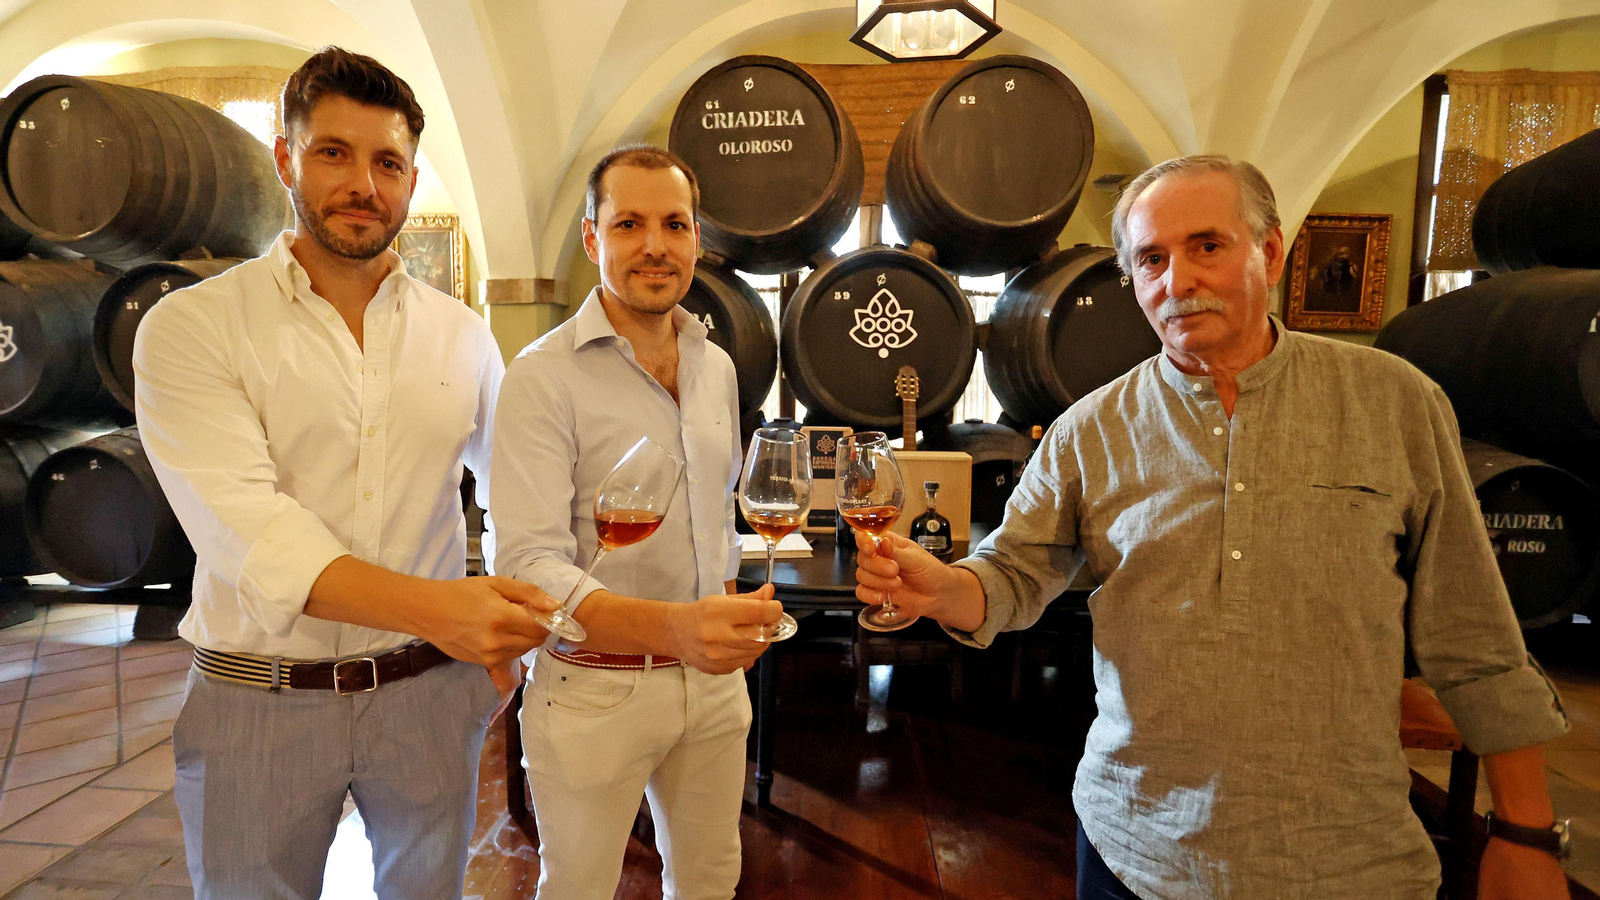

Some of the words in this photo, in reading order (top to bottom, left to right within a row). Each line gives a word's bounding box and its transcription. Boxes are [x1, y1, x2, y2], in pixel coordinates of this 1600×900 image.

[705, 99, 720, 110] 61
[959, 95, 976, 105] 62
[701, 109, 805, 130] CRIADERA
[718, 139, 793, 155] OLOROSO
[834, 291, 851, 301] 59
[126, 301, 139, 310] 51
[1483, 513, 1564, 530] RIADERA
[1507, 540, 1546, 553] ROSO
